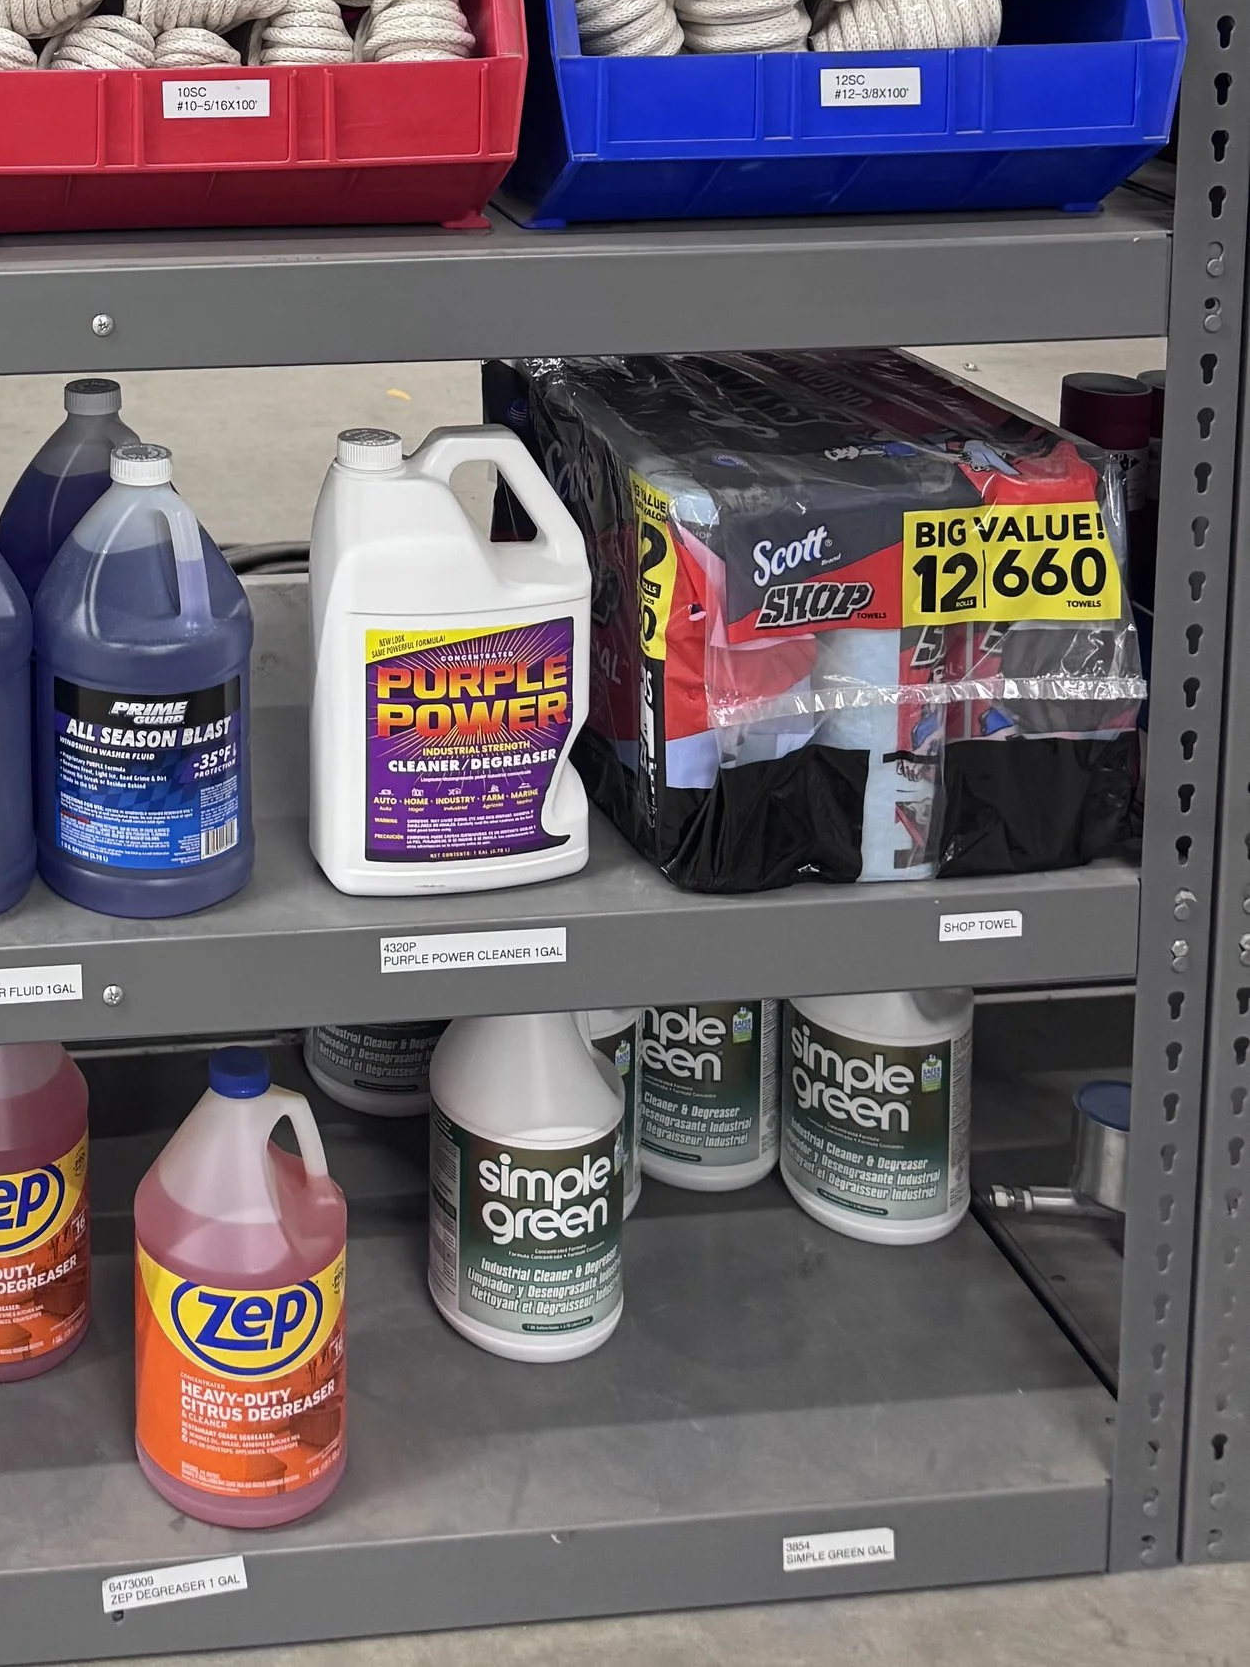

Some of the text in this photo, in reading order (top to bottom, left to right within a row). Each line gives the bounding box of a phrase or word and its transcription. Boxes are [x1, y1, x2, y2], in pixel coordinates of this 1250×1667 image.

[836, 75, 865, 85] 12SC
[177, 87, 206, 97] 10SC
[835, 88, 908, 99] #12-3/8X100'
[177, 100, 257, 111] #10-5/16X100'
[916, 513, 1104, 548] BIG VALUE!
[752, 525, 828, 587] Scott
[912, 547, 1106, 613] 12 660
[754, 582, 874, 629] SHOP
[377, 654, 568, 699] PURPLE
[110, 701, 188, 716] PRIME
[378, 692, 568, 738] POWER
[133, 716, 184, 724] GUARD
[66, 716, 231, 748] ALL SEASON BLAST
[422, 741, 531, 756] INDUSTRIAL STRENGTH
[944, 919, 1017, 932] SHOP TOWEL
[384, 942, 416, 953] 4320P
[384, 946, 562, 966] PURPLE POWER CLEANER 1GAL
[9, 985, 43, 997] FLUID
[48, 984, 76, 994] 1GAL
[791, 1025, 914, 1094] simple
[792, 1066, 909, 1131] green
[478, 1153, 610, 1210] simple
[482, 1197, 607, 1245] green
[181, 1381, 291, 1406] HEAVY-DUTY
[181, 1380, 335, 1421] CITRUS DEGREASER
[786, 1541, 809, 1552] 3854
[786, 1544, 891, 1564] SIMPLE GREEN GAL
[109, 1576, 153, 1592] 6473009
[111, 1574, 240, 1605] ZEP DEGREASER 1 GAL
